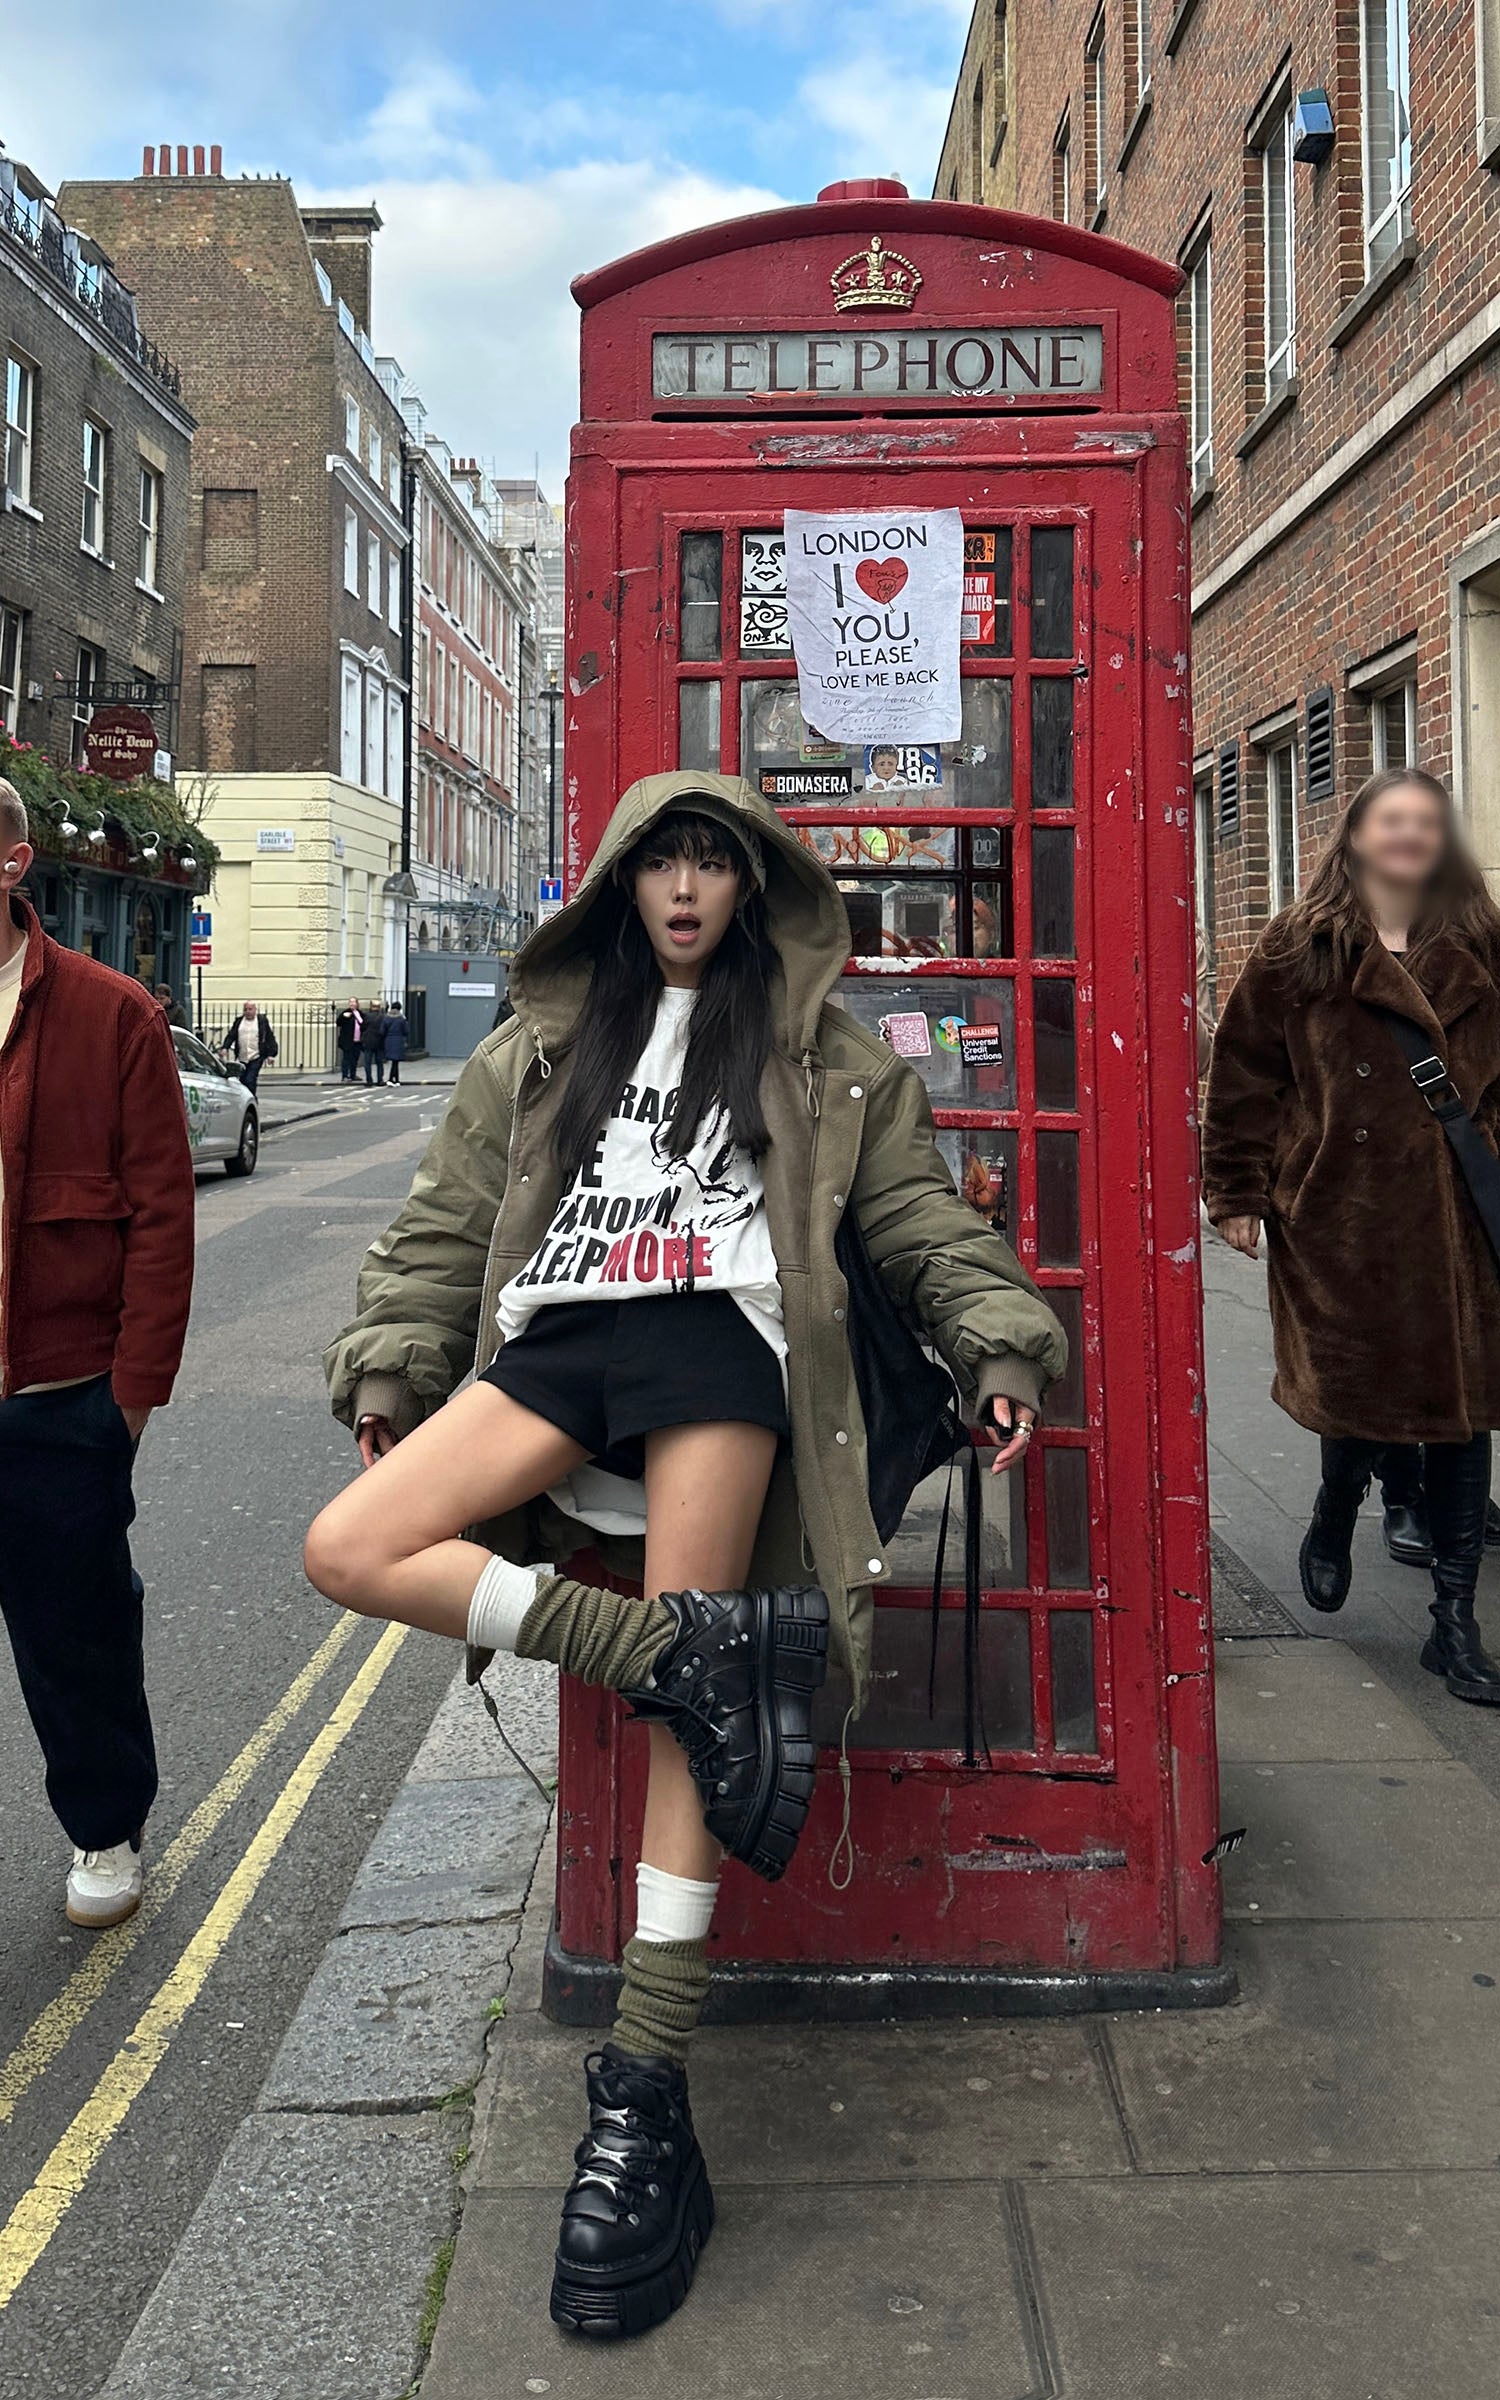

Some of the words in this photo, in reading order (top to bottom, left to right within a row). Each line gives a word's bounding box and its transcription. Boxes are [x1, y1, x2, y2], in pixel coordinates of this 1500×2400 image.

[669, 335, 1085, 393] TELEPHONE
[803, 525, 927, 555] LONDON
[833, 563, 844, 608] I
[975, 577, 988, 594] MY
[832, 612, 919, 648] YOU,
[836, 646, 913, 668] PLEASE
[820, 675, 860, 689] LOVE
[866, 673, 889, 687] ME
[895, 669, 939, 685] BACK
[88, 733, 123, 747] Nellie
[126, 735, 154, 748] Dean
[115, 750, 138, 759] Soho
[897, 747, 919, 770] 18
[906, 765, 937, 785] 96
[776, 776, 849, 794] BONASERA
[960, 1027, 999, 1037] CHALLENGE
[962, 1037, 998, 1047] Universal
[963, 1045, 988, 1054] Credit
[963, 1052, 1003, 1062] Sanctions
